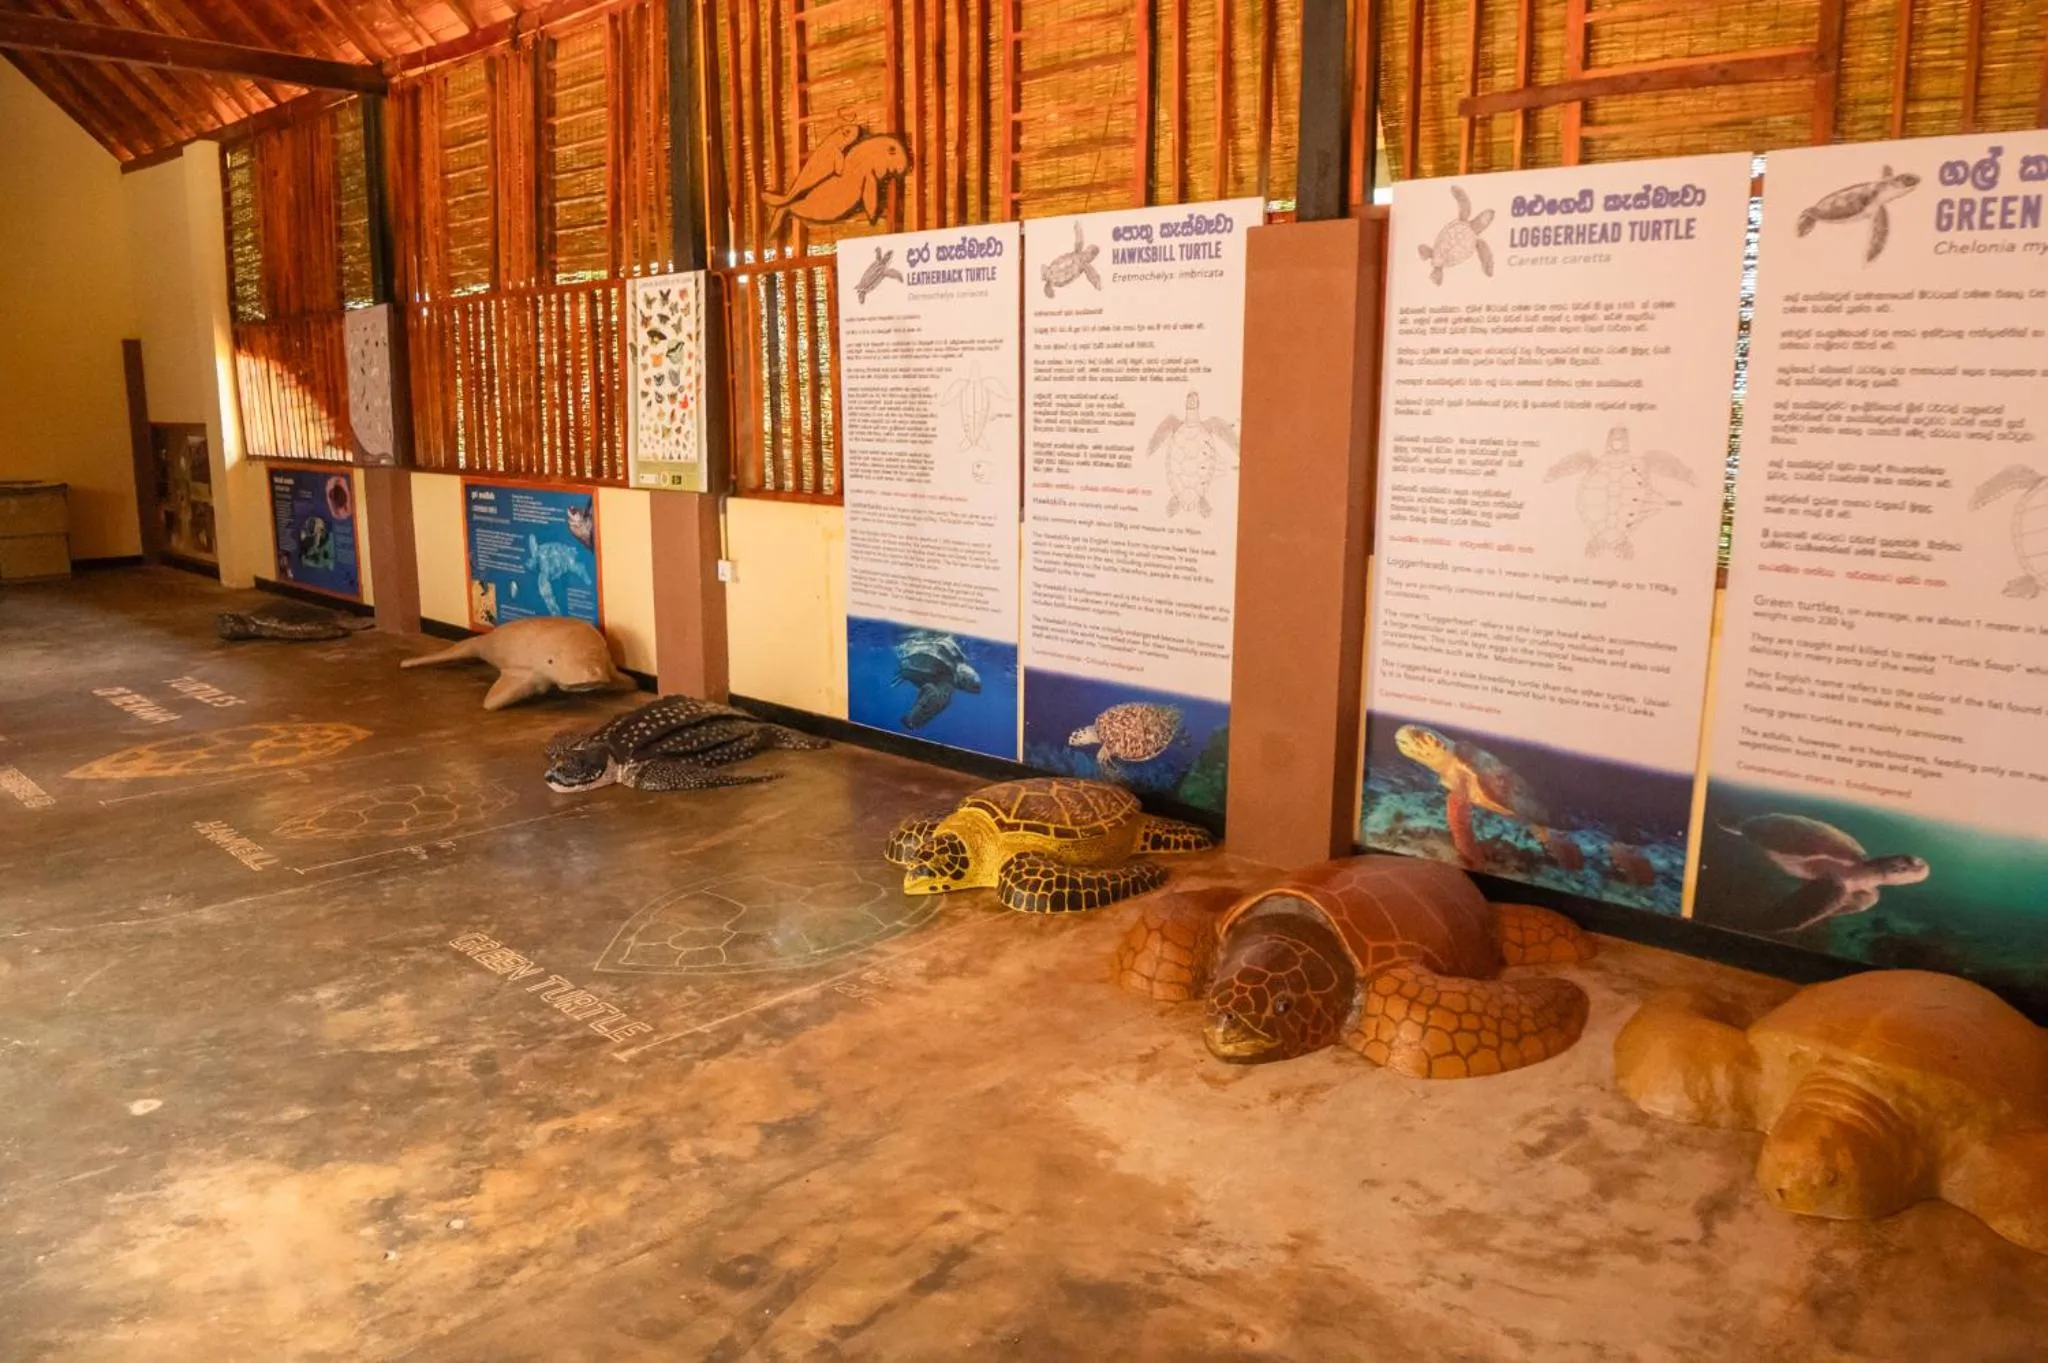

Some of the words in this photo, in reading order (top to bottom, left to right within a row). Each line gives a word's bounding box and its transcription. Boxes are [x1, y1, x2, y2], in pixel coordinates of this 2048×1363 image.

[1939, 146, 2003, 191] ගල්
[1935, 194, 2042, 232] GREEN
[1509, 221, 1621, 248] LOGGERHEAD
[1628, 218, 1696, 242] TURTLE
[1112, 245, 1175, 265] HAWKSBILL
[1179, 241, 1222, 260] TURTLE
[1508, 254, 1557, 266] Caretta
[1562, 253, 1611, 264] caretta
[1934, 240, 2017, 255] Chelonia
[907, 269, 963, 286] LEATHERBACK
[965, 266, 996, 282] TURTLE
[1387, 555, 1449, 570] Loggerheads
[1452, 564, 1471, 573] grow
[1474, 567, 1484, 575] up
[1487, 567, 1496, 575] to
[1542, 571, 1569, 584] length
[1573, 576, 1589, 585] and
[1592, 577, 1618, 589] weigh
[1620, 582, 1632, 590] up
[1636, 582, 1646, 590] to
[1386, 578, 1403, 588] They
[1420, 582, 1452, 594] primarily
[1498, 590, 1514, 599] and
[1590, 600, 1607, 609] and
[1753, 592, 1794, 608] Green
[1916, 614, 1933, 624] are
[1384, 608, 1397, 617] The
[1400, 612, 1420, 620] name
[1506, 624, 1514, 632] to
[1516, 624, 1531, 634] the
[1476, 652, 1489, 660] the
[1489, 642, 1508, 654] eggs
[1520, 646, 1534, 656] the
[1610, 658, 1628, 669] and
[1607, 648, 1624, 656] and
[1751, 632, 1774, 644] They
[1778, 637, 1793, 646] are
[1836, 642, 1856, 654] and
[1890, 650, 1903, 659] to
[1804, 653, 1833, 664] many
[1866, 658, 1878, 668] of
[1563, 684, 1578, 695] the
[1847, 694, 1859, 704] to
[1880, 686, 1892, 696] to
[1895, 688, 1914, 698] the
[1964, 697, 1984, 708] the
[1744, 704, 1774, 718] Young
[1777, 710, 1808, 720] green
[1810, 713, 1844, 726] turtles
[1846, 720, 1864, 729] are
[1740, 725, 1758, 736] The
[1848, 745, 1866, 754] are
[1934, 756, 1978, 774] feeding
[1887, 762, 1908, 774] and
[449, 932, 544, 980] GREEN
[526, 974, 653, 1043] TURTLE
